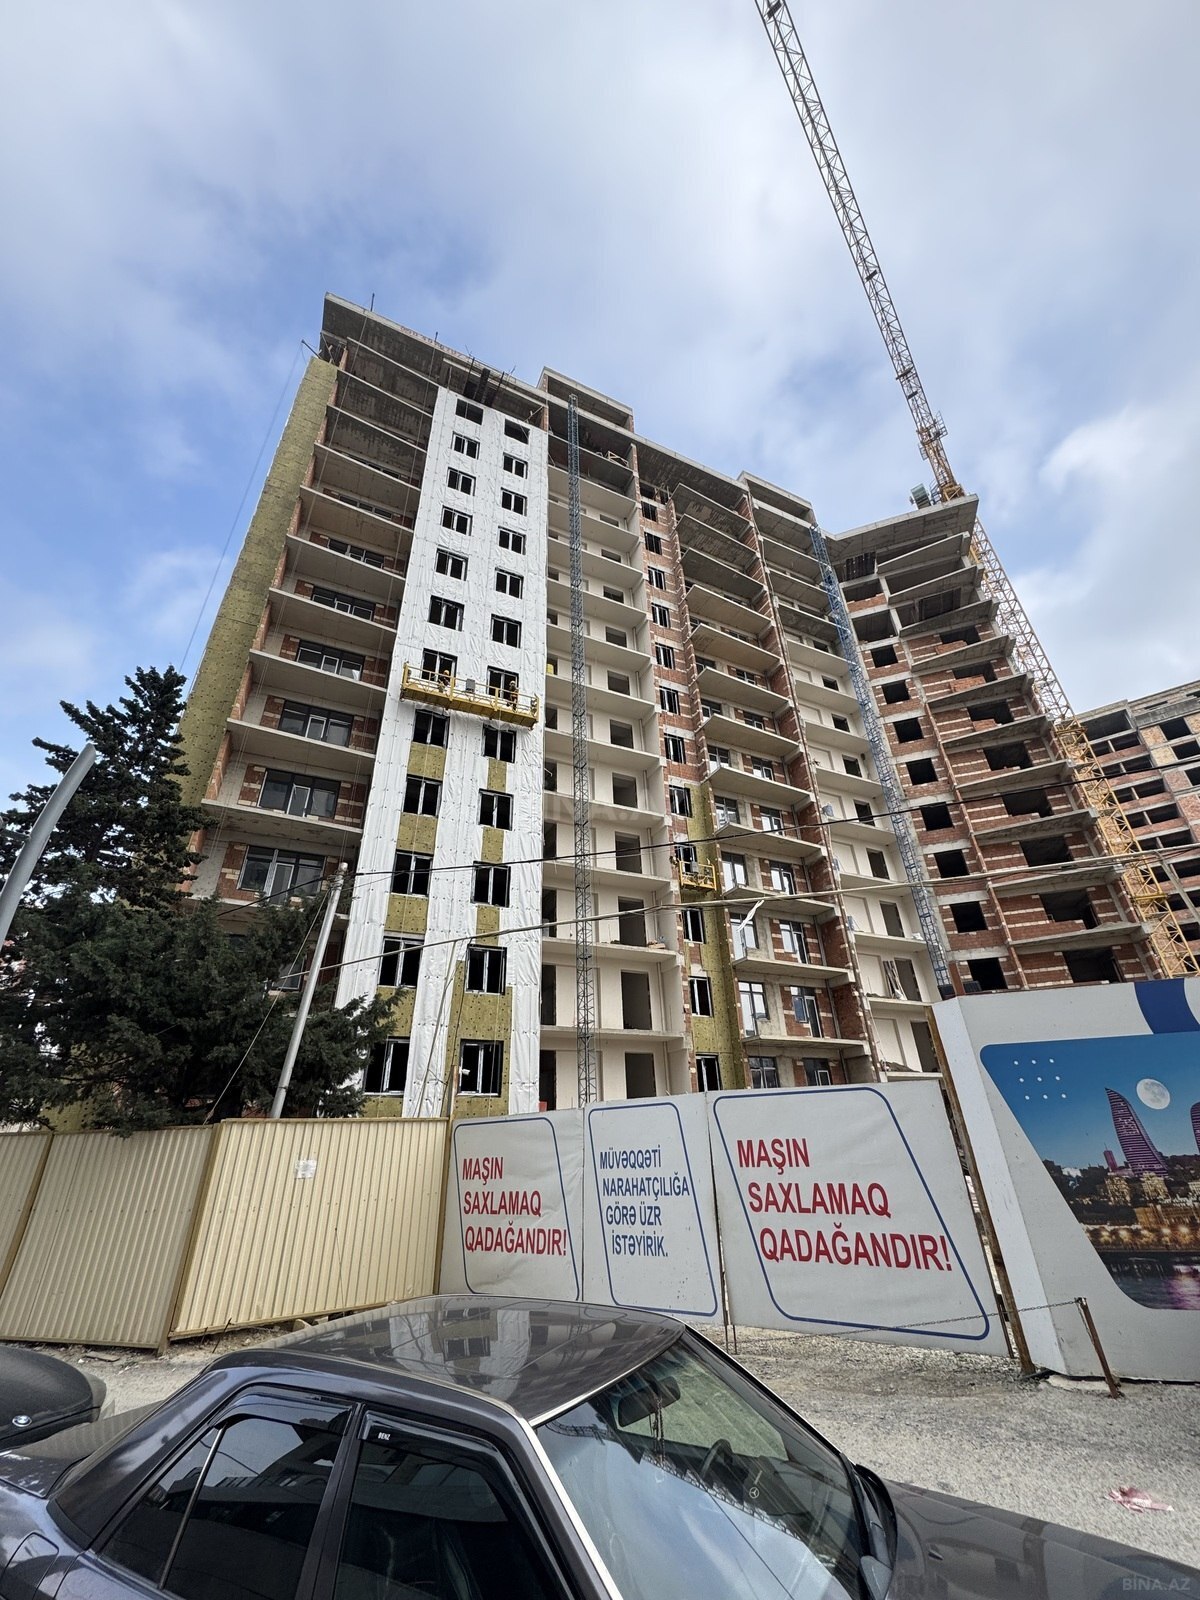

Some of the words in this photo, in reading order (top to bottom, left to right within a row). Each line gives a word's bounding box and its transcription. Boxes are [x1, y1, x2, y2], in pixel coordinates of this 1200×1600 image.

[462, 1156, 504, 1186] MAŞIN
[736, 1138, 810, 1175] MAŞIN
[602, 1171, 690, 1201] NARAHATÇILIĞA
[747, 1182, 892, 1219] SAXLAMAQ
[463, 1190, 542, 1218] SAXLAMAQ
[605, 1202, 637, 1226] GÖRƏ
[639, 1201, 662, 1227] ÜZR
[464, 1220, 567, 1257] QADAĞANDIR!
[759, 1221, 953, 1272] QADAĞANDIR!
